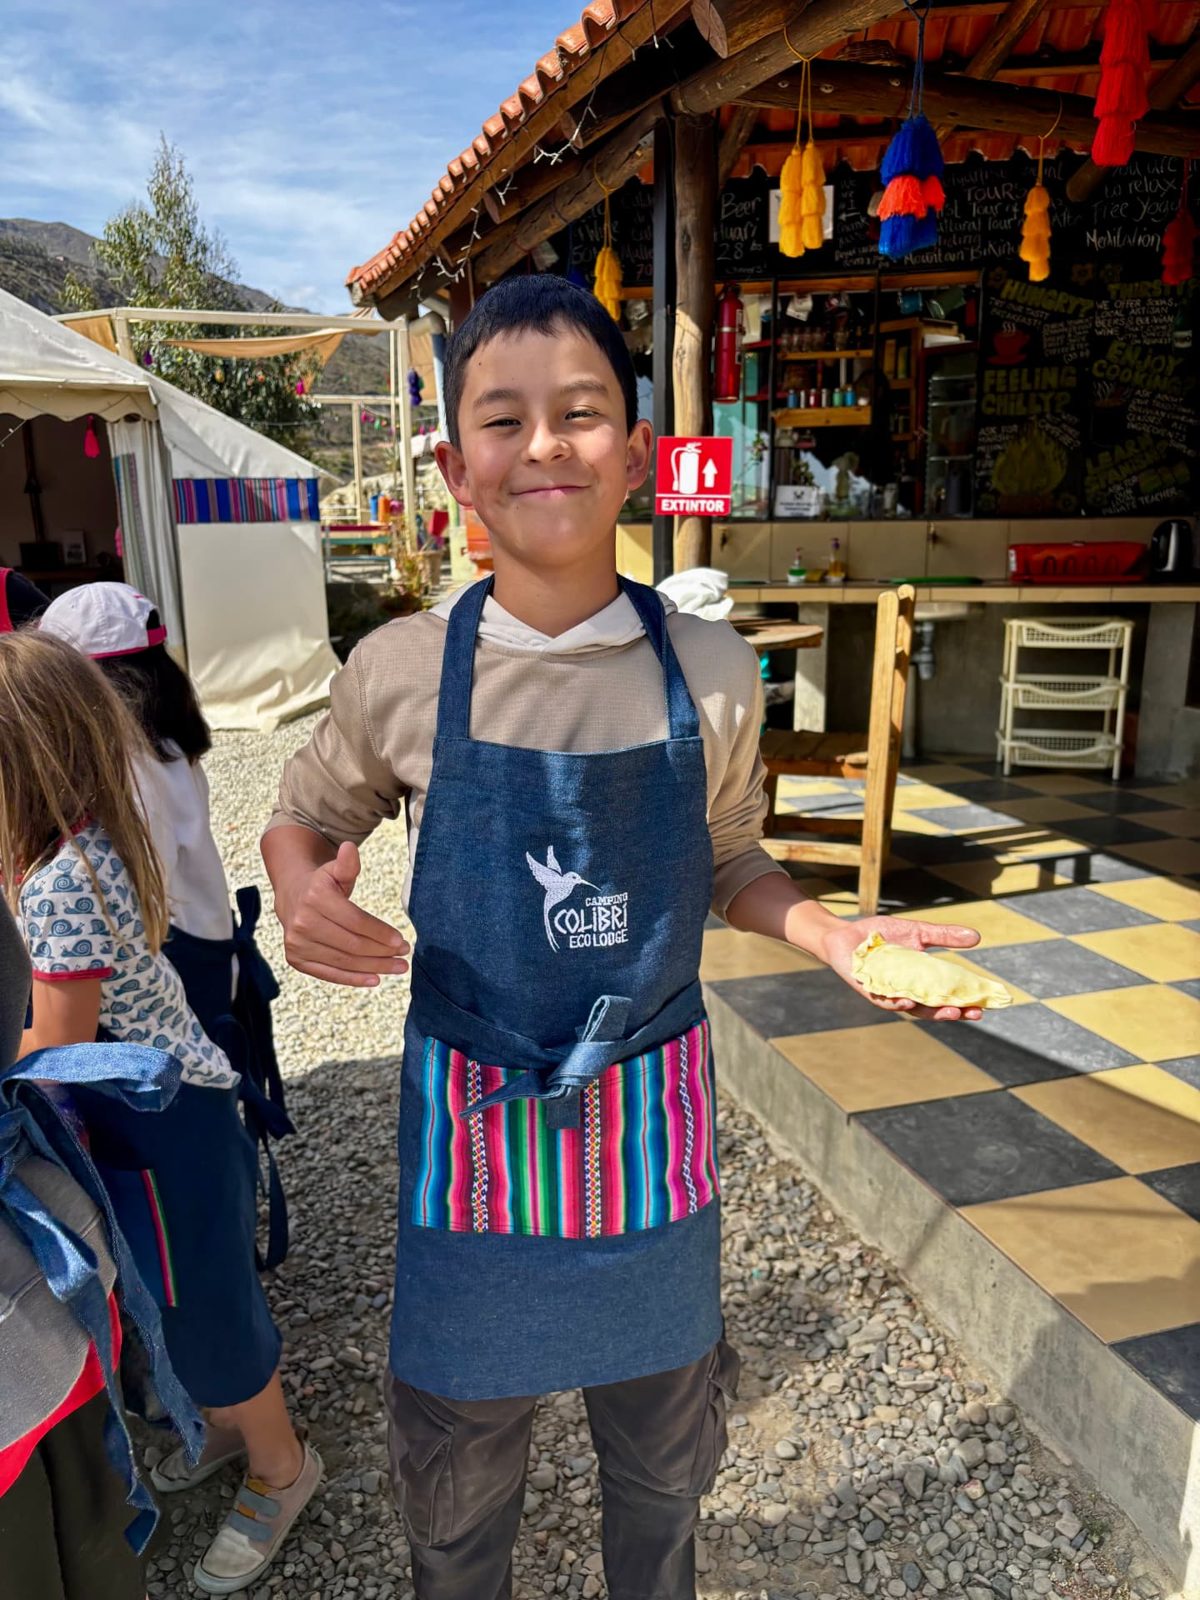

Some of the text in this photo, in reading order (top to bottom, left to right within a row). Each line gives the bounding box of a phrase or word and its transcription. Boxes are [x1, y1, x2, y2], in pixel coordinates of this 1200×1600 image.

[1128, 175, 1177, 198] relax
[720, 192, 762, 220] Beer
[1000, 278, 1095, 318] HUNGRY?
[983, 366, 1078, 393] FEELING
[661, 499, 725, 512] EXTINTOR
[585, 892, 629, 907] CAMPING
